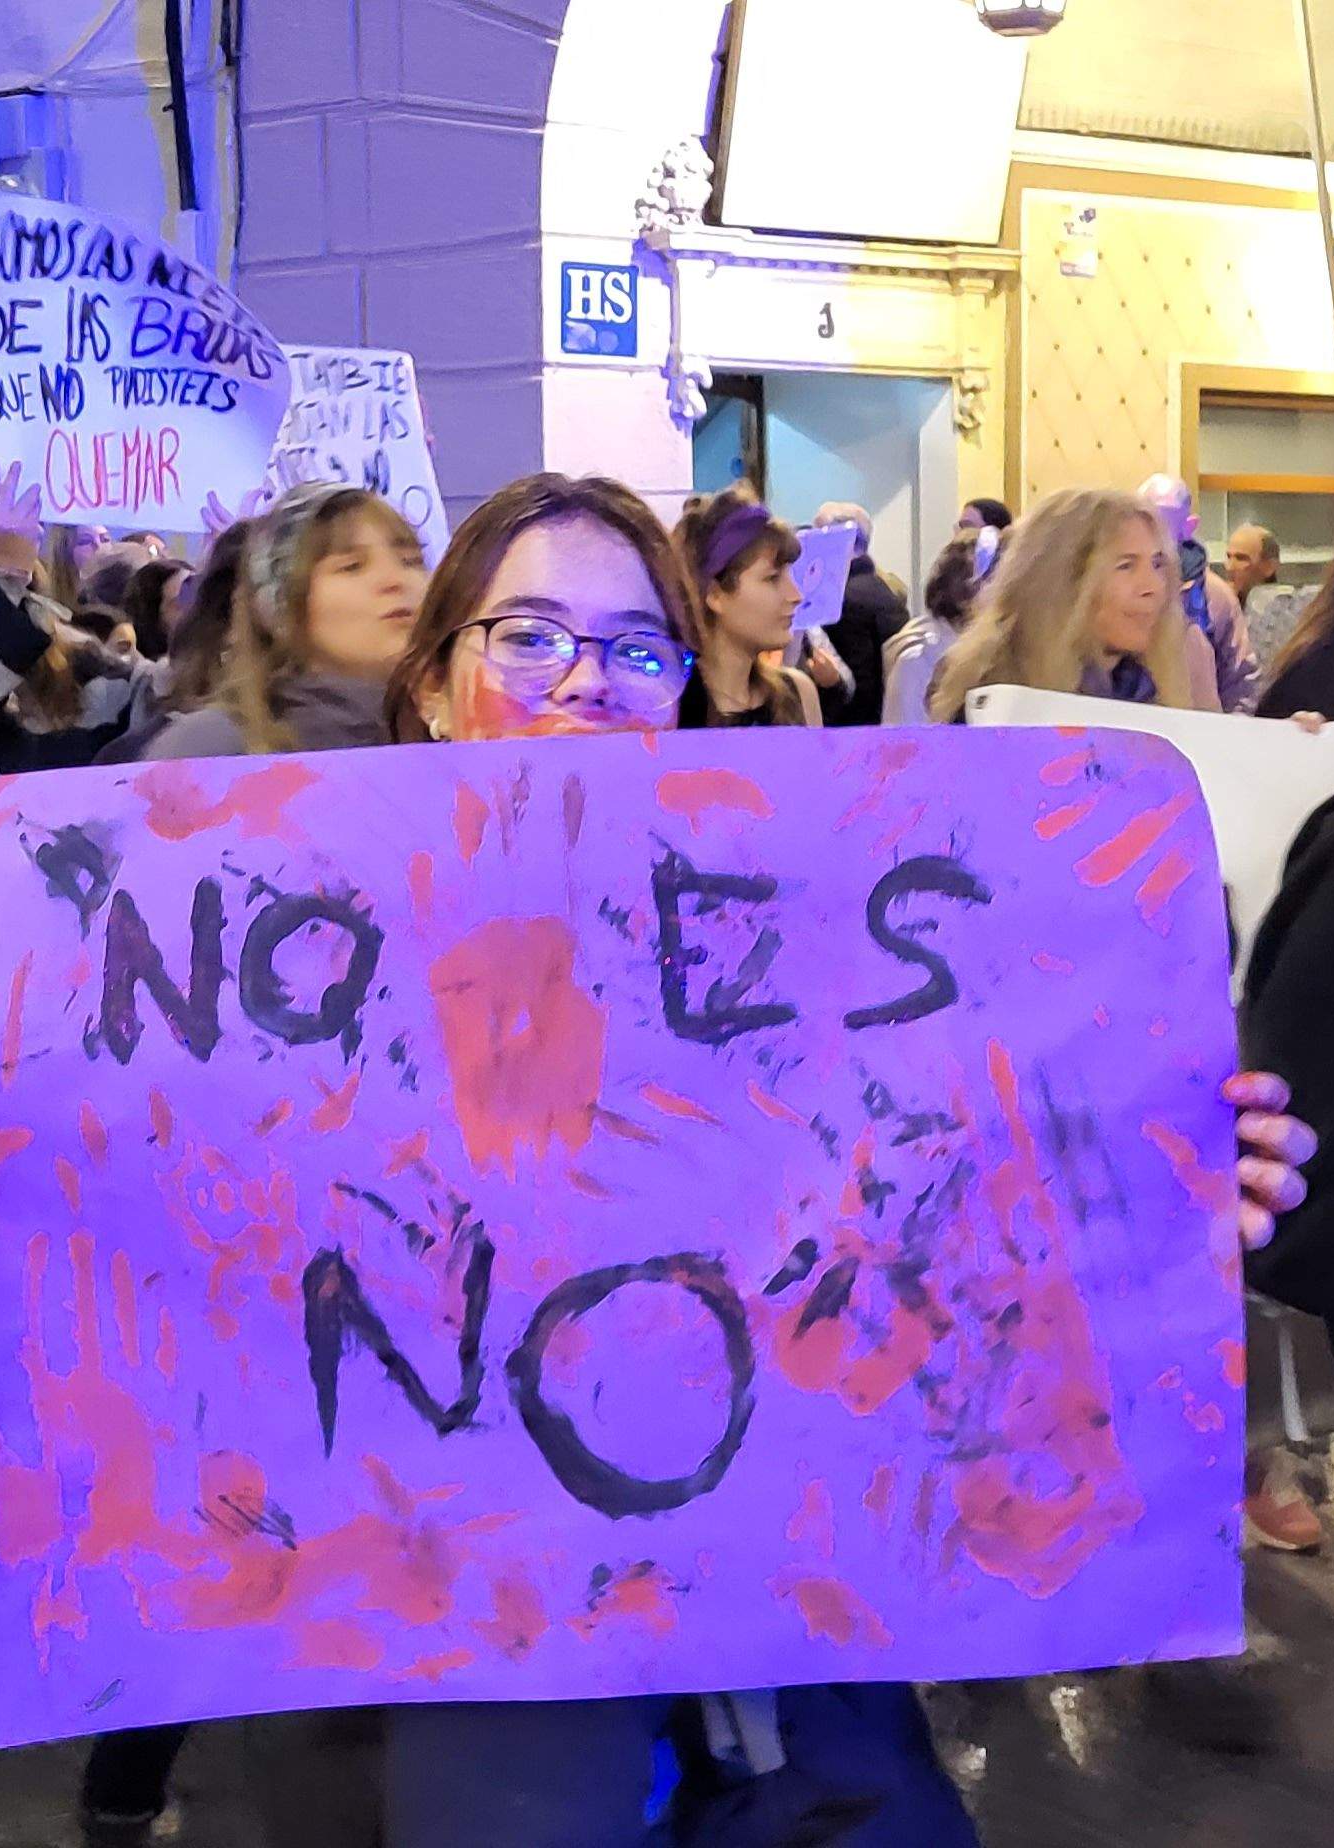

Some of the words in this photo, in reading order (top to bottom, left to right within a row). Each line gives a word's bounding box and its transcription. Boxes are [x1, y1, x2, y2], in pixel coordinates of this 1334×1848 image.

[66, 286, 111, 362] LAS
[566, 267, 634, 324] HS
[39, 363, 85, 424] NO
[45, 425, 181, 513] QUEMAR
[97, 876, 386, 1064] NO
[657, 848, 995, 1043] ES
[301, 1215, 757, 1522] NO
